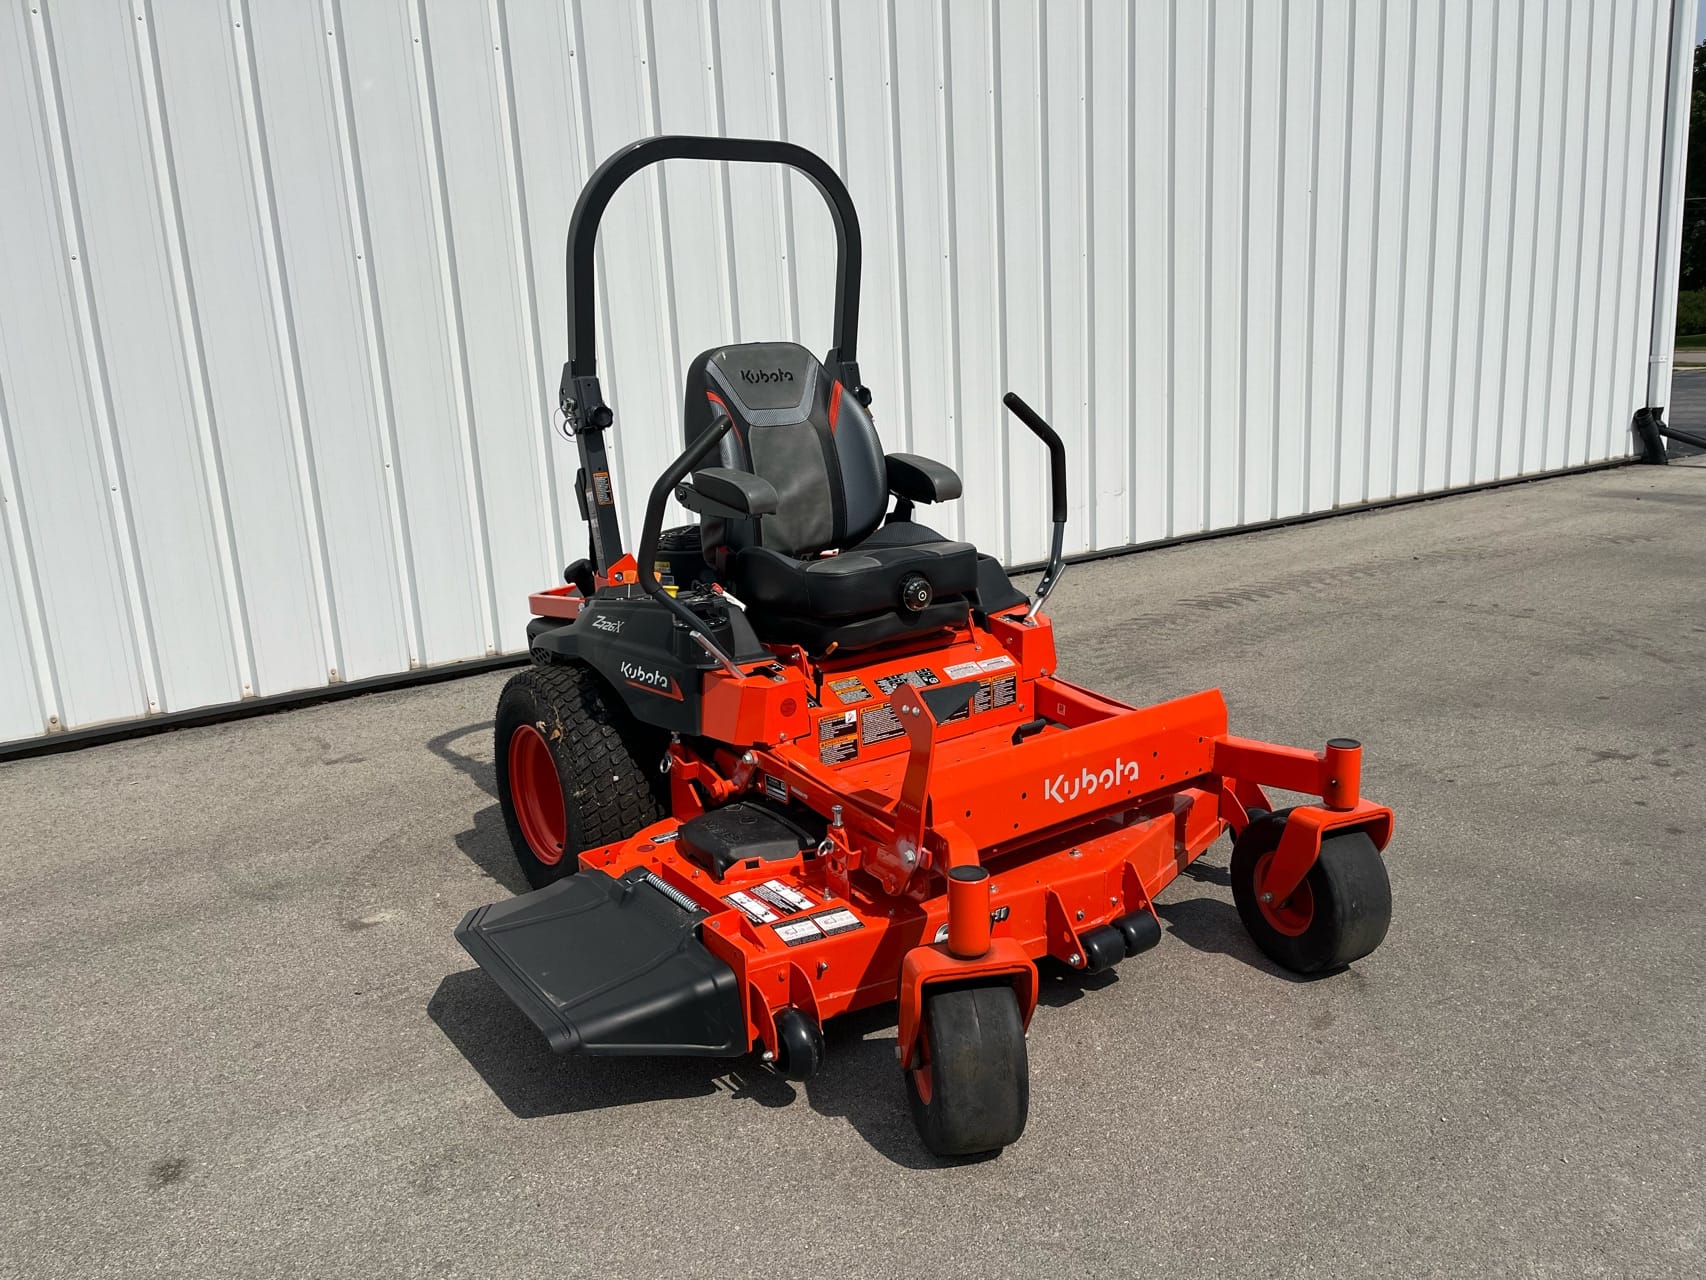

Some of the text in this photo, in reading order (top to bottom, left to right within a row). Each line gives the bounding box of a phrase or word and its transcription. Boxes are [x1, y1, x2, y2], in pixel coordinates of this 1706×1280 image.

[740, 368, 794, 384] Kubota
[620, 661, 668, 688] Kubota
[1044, 757, 1139, 804] Kubota
